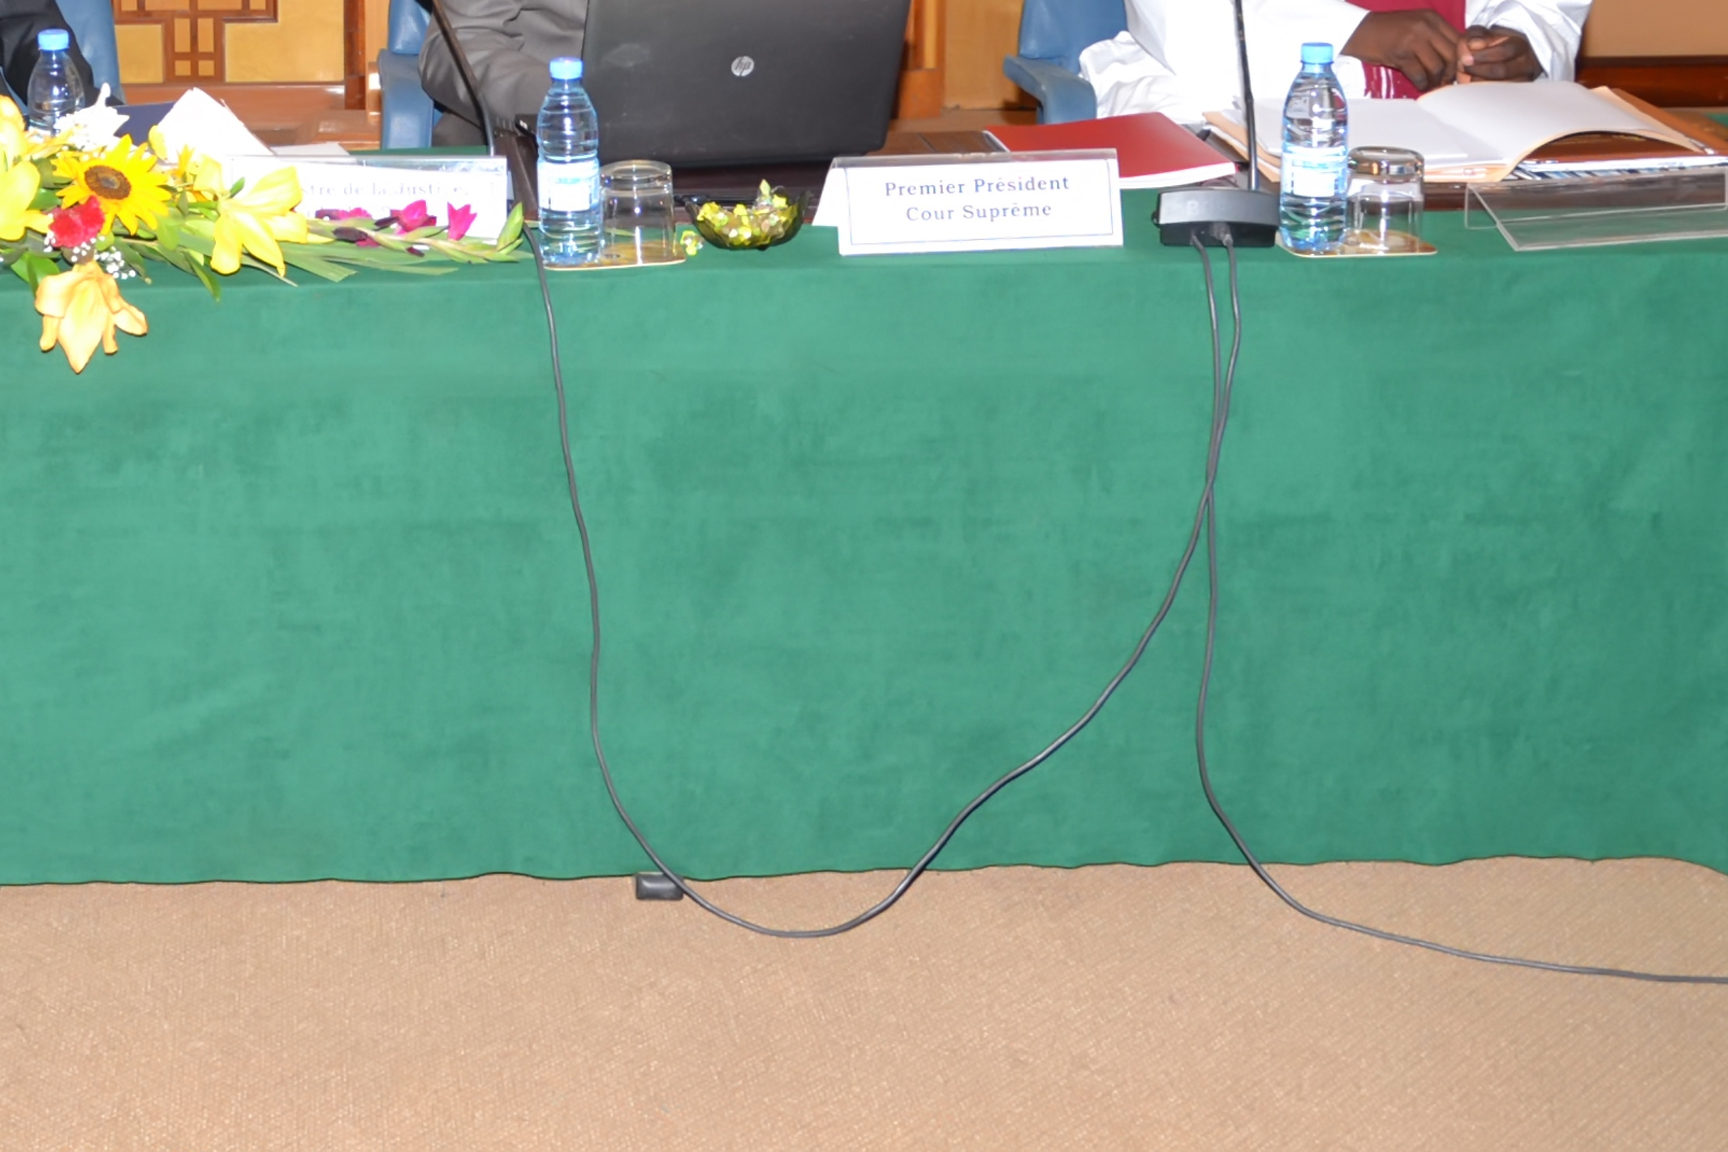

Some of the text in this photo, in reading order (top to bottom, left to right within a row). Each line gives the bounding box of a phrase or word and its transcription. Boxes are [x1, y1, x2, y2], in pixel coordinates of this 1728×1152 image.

[884, 176, 1070, 196] Premier Président
[905, 203, 1052, 222] Cour Suprême
